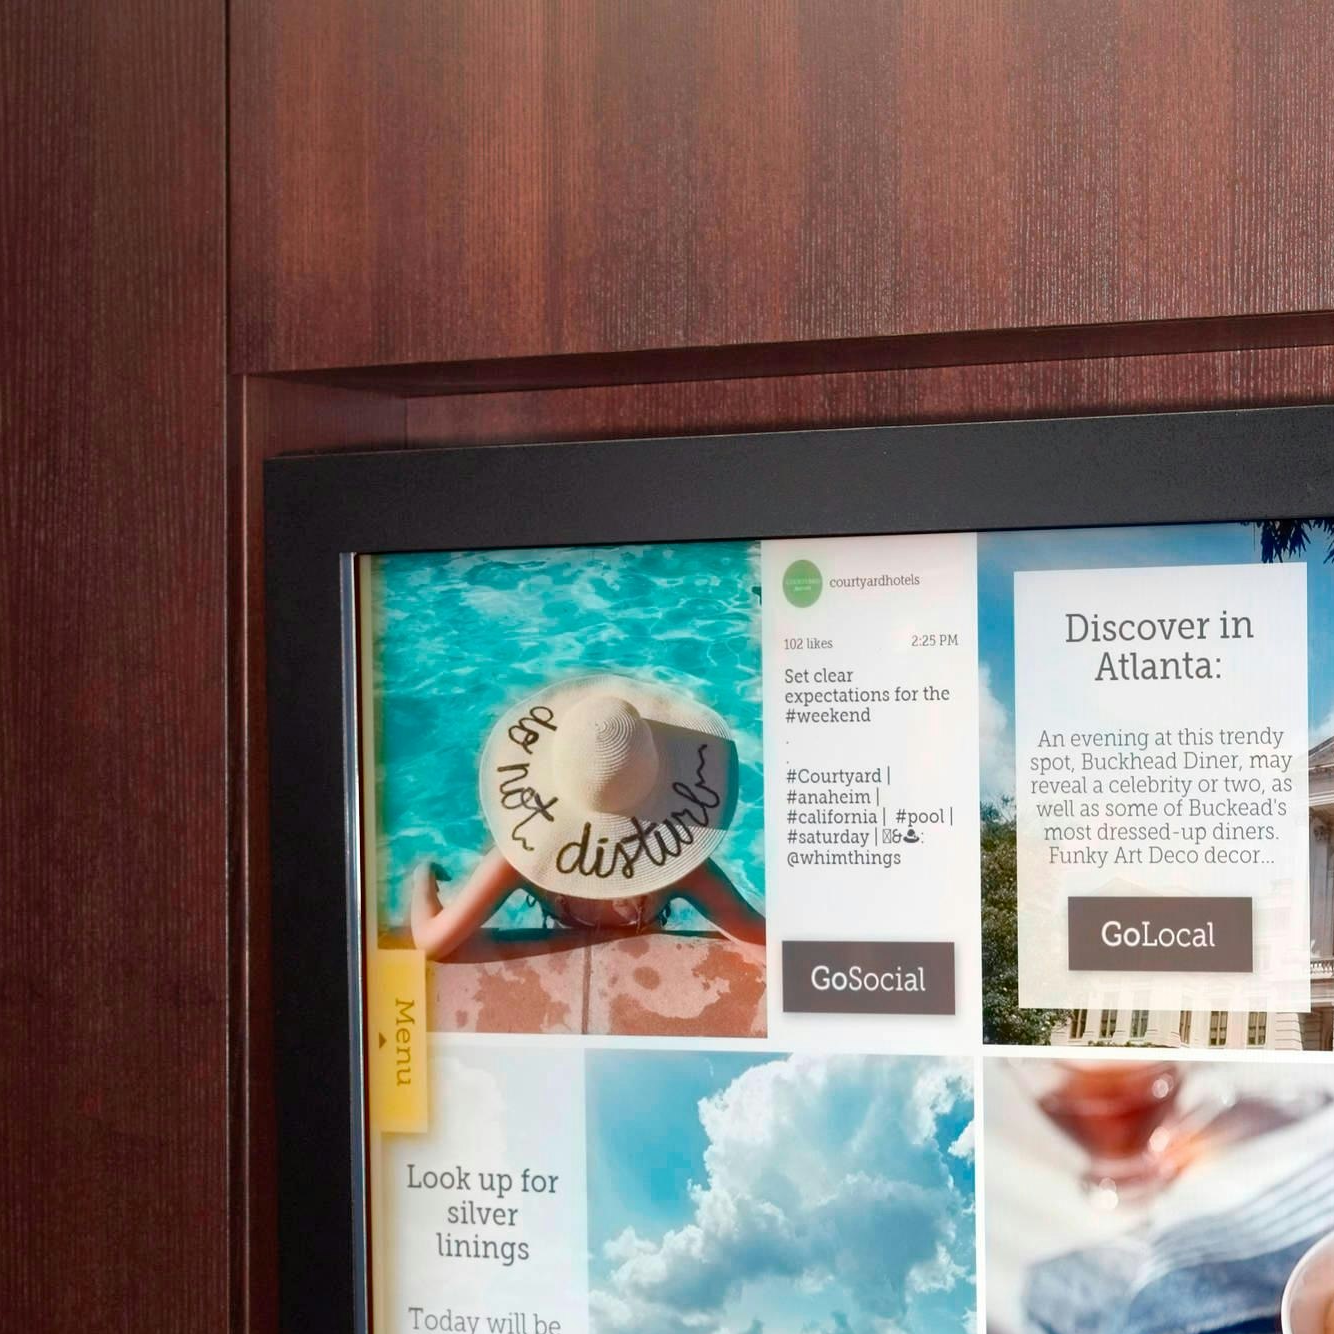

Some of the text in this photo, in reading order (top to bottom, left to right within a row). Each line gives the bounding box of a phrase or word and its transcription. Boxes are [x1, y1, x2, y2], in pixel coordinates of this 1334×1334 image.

[830, 574, 920, 593] courtyardhotels
[1066, 610, 1255, 644] Discover in
[785, 638, 833, 650] 102 likes
[911, 634, 959, 647] 2:25 PM
[785, 668, 853, 683] Set clear
[1094, 652, 1223, 681] Atlanta:
[785, 686, 950, 707] expectations for the
[785, 707, 871, 723] #weekend
[1038, 727, 1285, 752] An evening at this trendy
[1030, 751, 1292, 776] spot, Buckhead Diner, may
[786, 768, 881, 786] #Courtyard
[1031, 776, 1292, 799] reveal a celebrity or two, as
[496, 705, 721, 879] do not disturb
[787, 789, 871, 805] #anaheim
[787, 809, 877, 825] #california
[896, 808, 944, 827] #pool
[1037, 798, 1287, 817] well as some of Buckead's
[787, 830, 869, 847] #saturday
[1044, 821, 1279, 845] most dressed-up diners.
[787, 850, 901, 868] @whimthings
[1049, 845, 1275, 869] Funky Art Deco decor...
[1101, 920, 1215, 948] GoLocal
[811, 965, 926, 991] GoSocial
[394, 999, 416, 1088] Menu
[407, 1165, 559, 1200] Look up for
[447, 1201, 518, 1227] silver
[436, 1232, 530, 1265] linings
